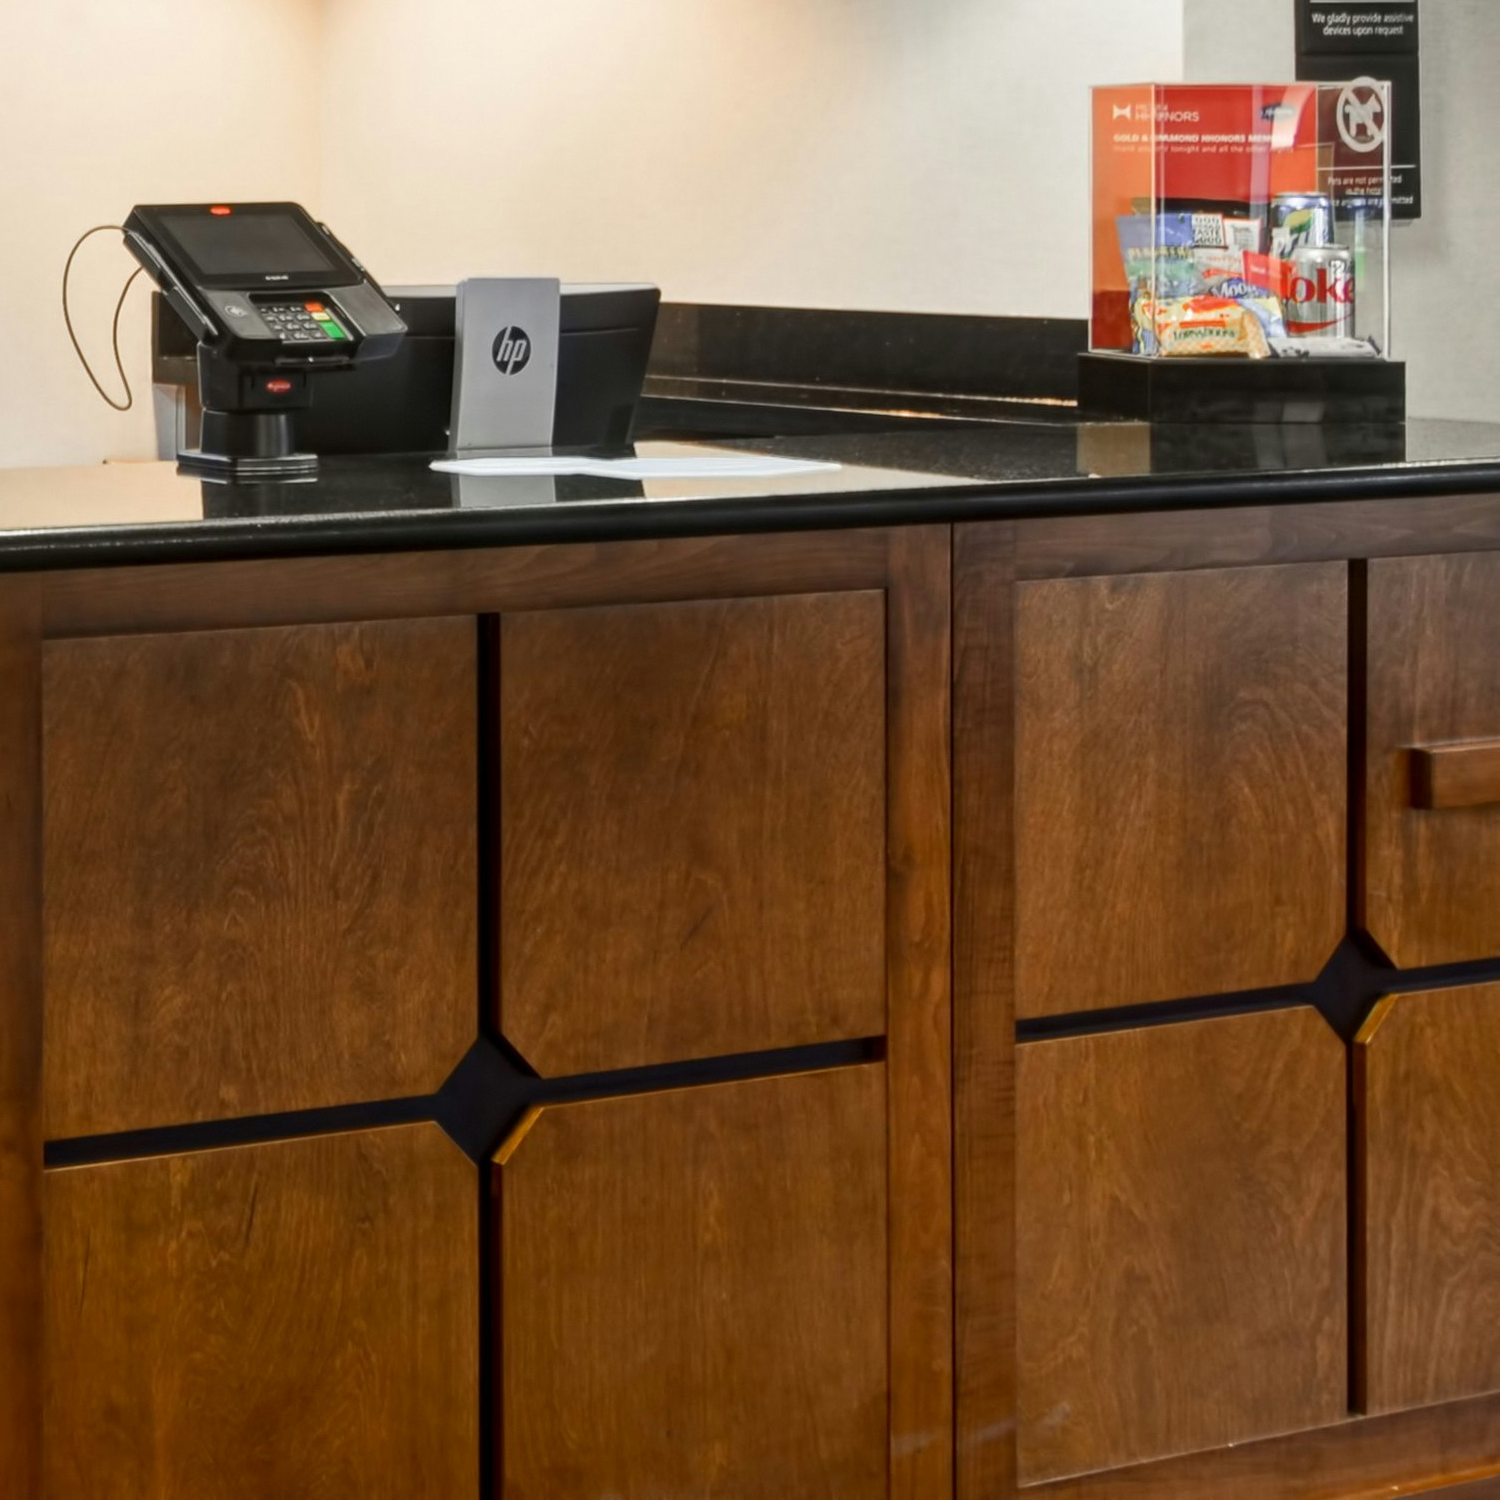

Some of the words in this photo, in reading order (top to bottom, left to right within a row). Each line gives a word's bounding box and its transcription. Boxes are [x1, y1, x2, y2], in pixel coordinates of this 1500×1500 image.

[1311, 12, 1326, 23] We
[1327, 12, 1351, 26] gladly
[1352, 13, 1382, 25] provide
[1383, 13, 1414, 23] assistive
[1323, 26, 1351, 36] devices
[1352, 26, 1373, 37] upon
[1374, 25, 1403, 37] request
[1113, 133, 1139, 143] GOLD
[1201, 133, 1246, 143] HHONORS
[1368, 174, 1402, 185] permted
[1283, 266, 1355, 304] oke
[494, 326, 529, 375] hp
